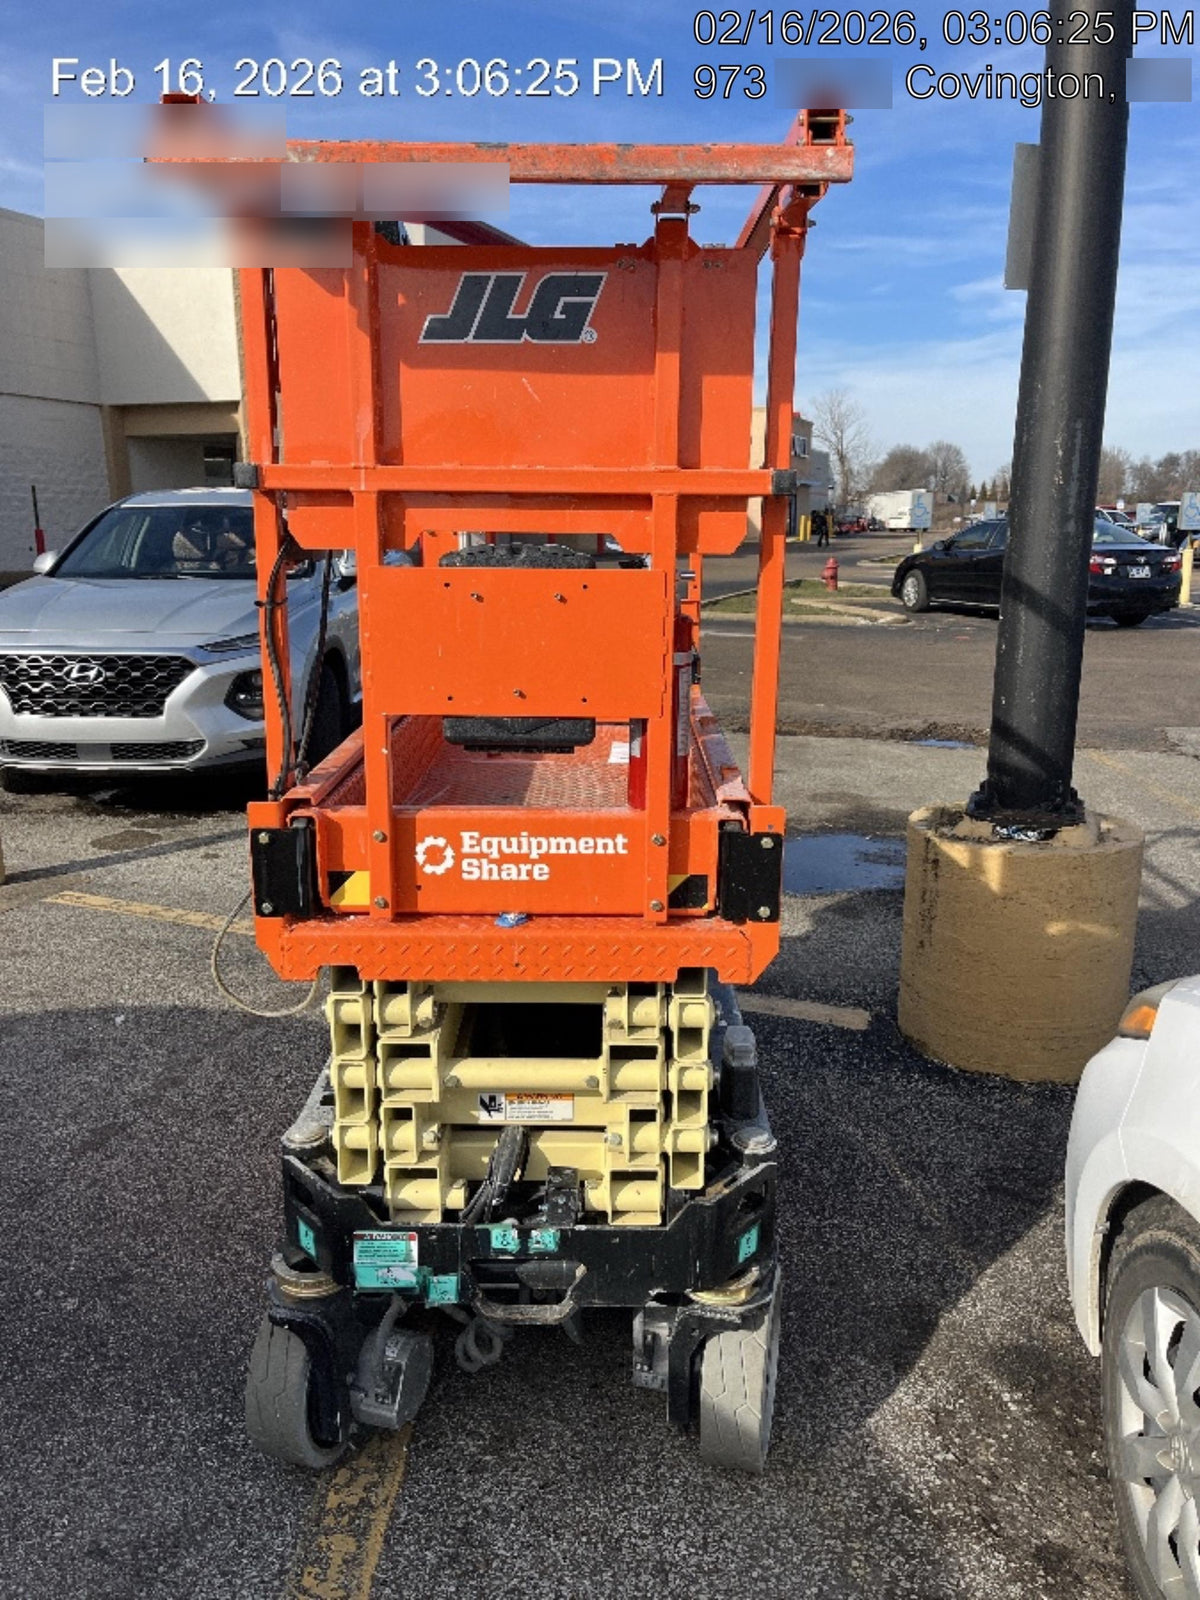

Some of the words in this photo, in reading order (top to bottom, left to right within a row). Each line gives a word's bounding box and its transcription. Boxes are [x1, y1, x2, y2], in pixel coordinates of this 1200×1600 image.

[418, 272, 607, 343] JLG
[460, 831, 628, 859] Equipment
[461, 858, 550, 881] Share
